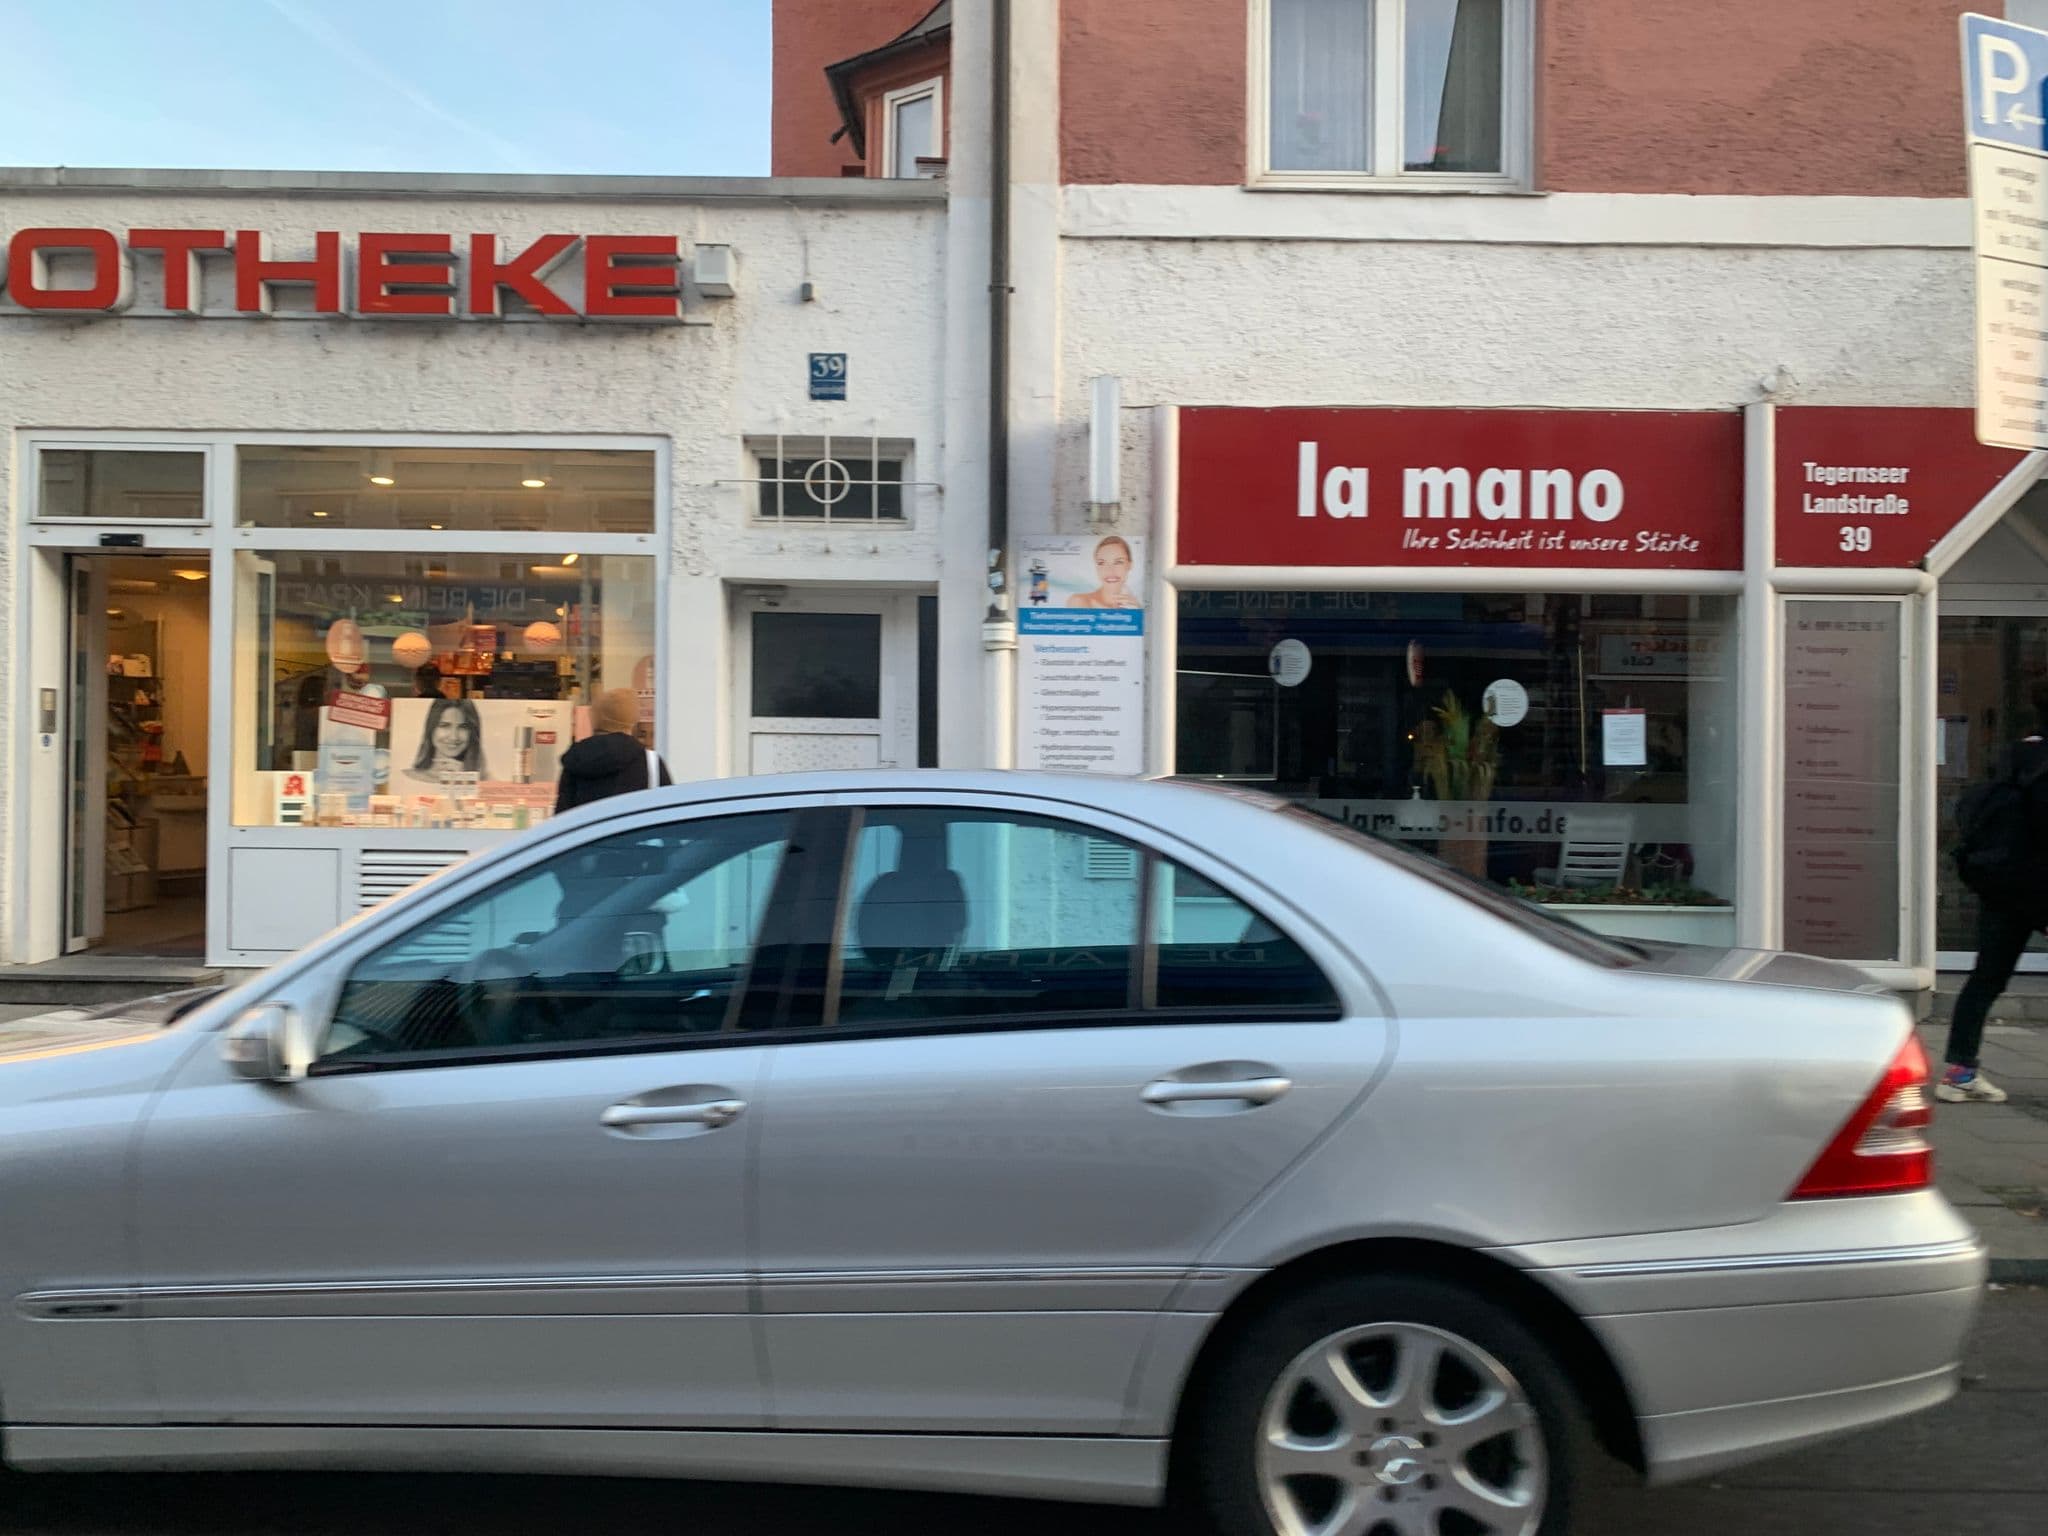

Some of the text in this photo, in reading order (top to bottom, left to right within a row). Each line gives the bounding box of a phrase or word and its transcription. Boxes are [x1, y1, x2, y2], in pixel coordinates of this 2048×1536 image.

[1978, 33, 2030, 124] P
[8, 228, 678, 316] OTHEKE
[812, 356, 844, 377] 39
[1297, 441, 1625, 522] la mano
[1802, 462, 1910, 486] Tegernseer
[1803, 494, 1909, 515] Landstraße
[1402, 528, 1700, 552] Ihre Schönheit ist unsere Stärke
[1839, 526, 1872, 552] 39
[1343, 804, 1568, 835] lamo-info.de
